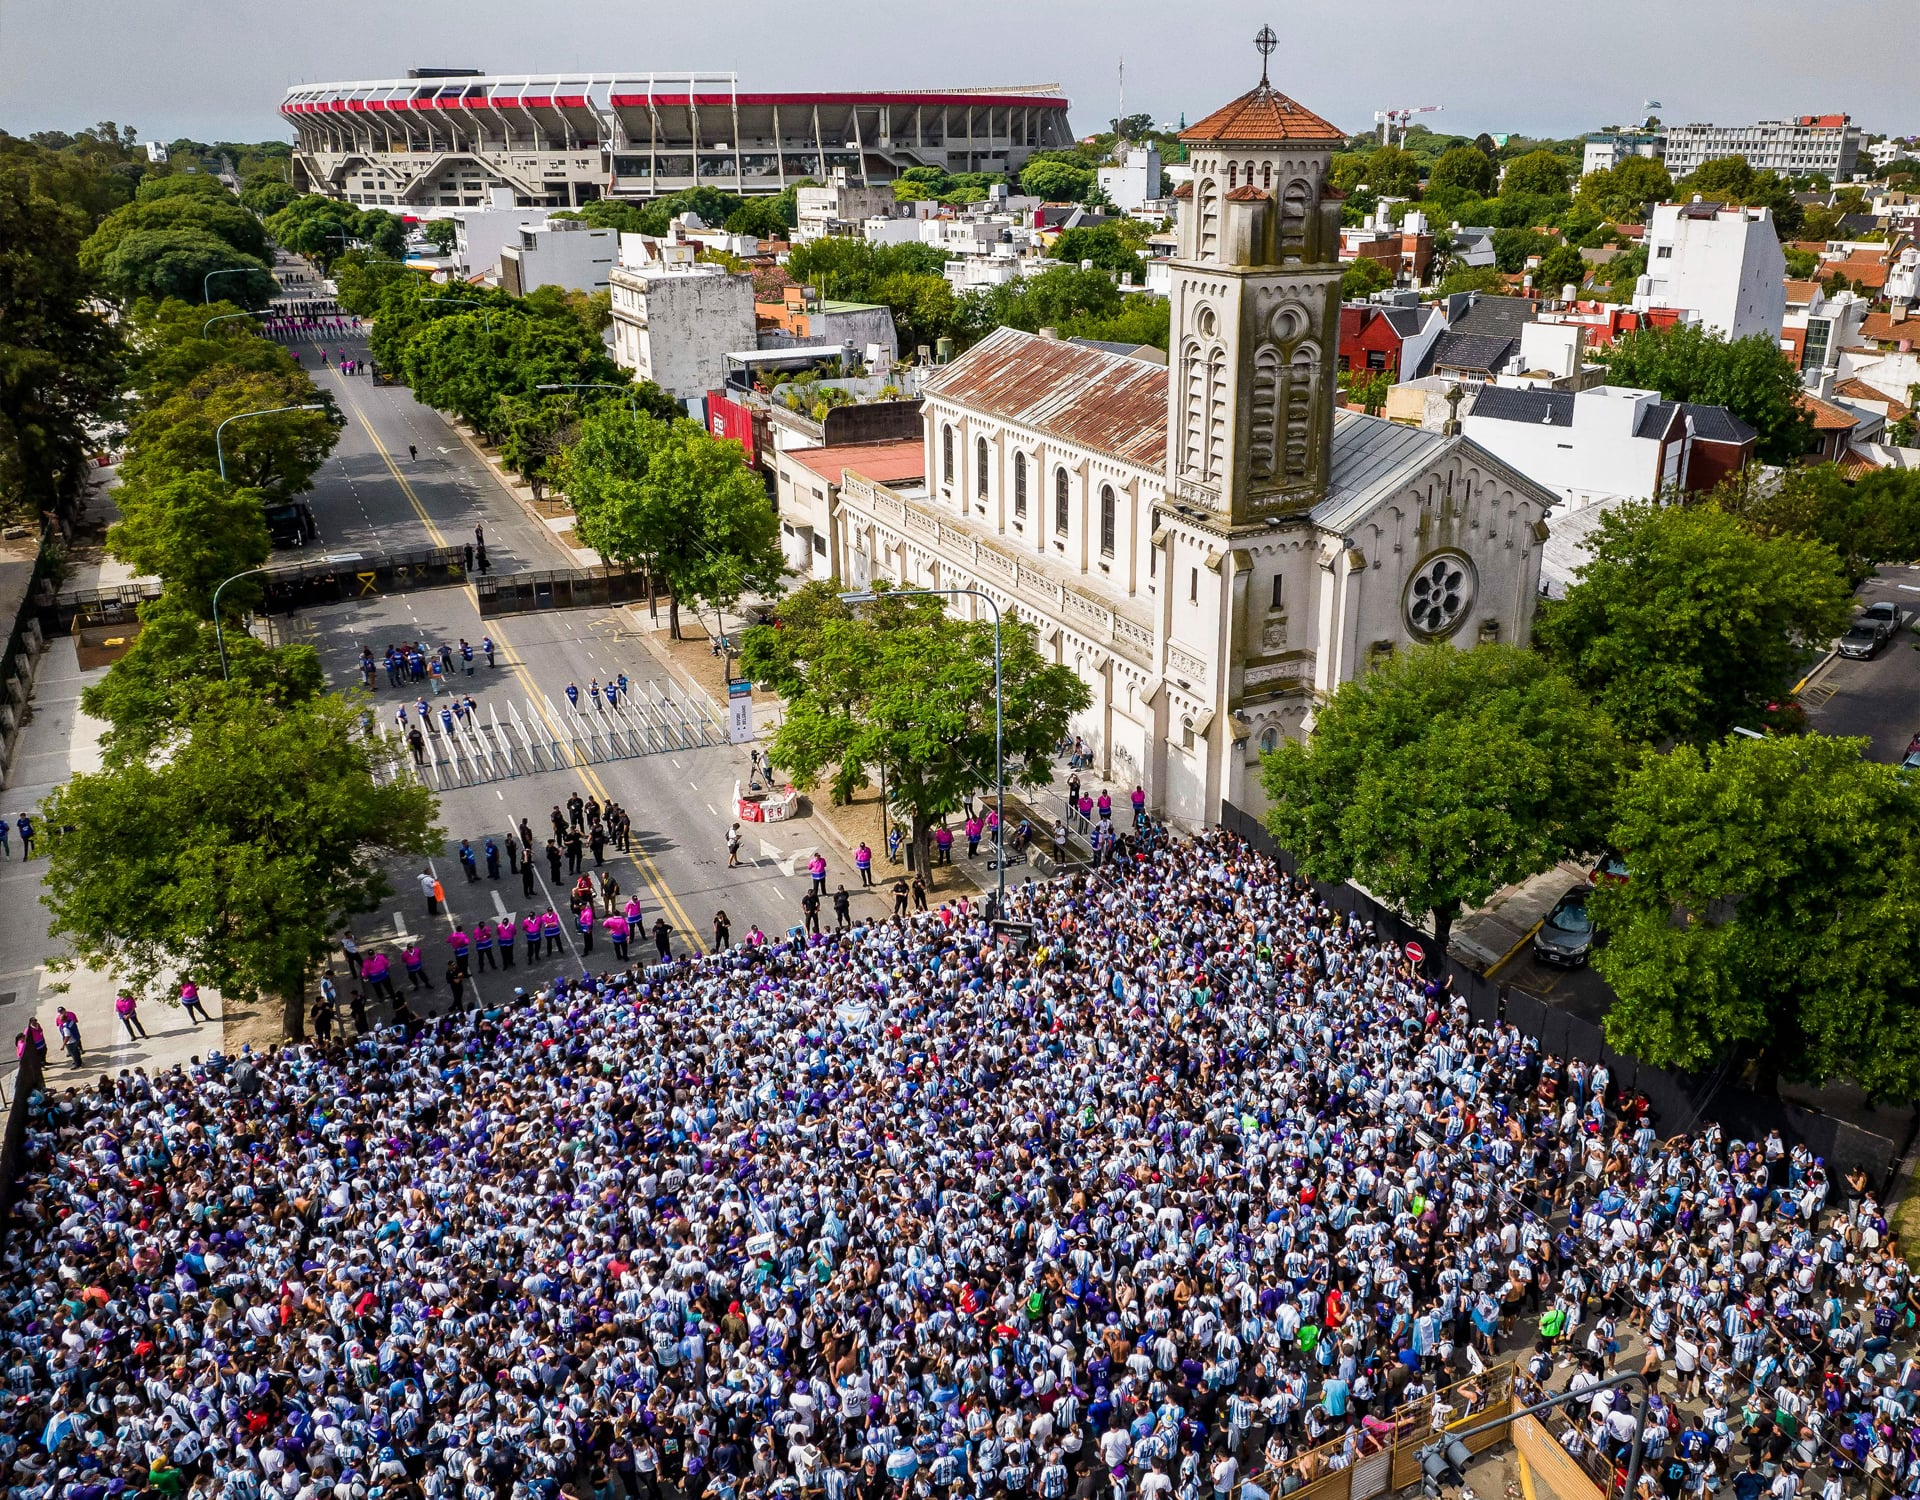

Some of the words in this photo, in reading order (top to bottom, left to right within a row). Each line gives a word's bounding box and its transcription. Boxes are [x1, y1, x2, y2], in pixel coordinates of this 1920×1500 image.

[669, 1176, 679, 1186] 10
[1202, 1319, 1212, 1332] 10
[1880, 1318, 1890, 1327] 10
[1098, 1371, 1107, 1379] 10
[1190, 1429, 1197, 1437] 7
[184, 1439, 197, 1455] 10
[1656, 1439, 1664, 1448] 10
[1841, 1460, 1852, 1469] 10
[1668, 1467, 1683, 1479] 10
[232, 1481, 247, 1490] 10
